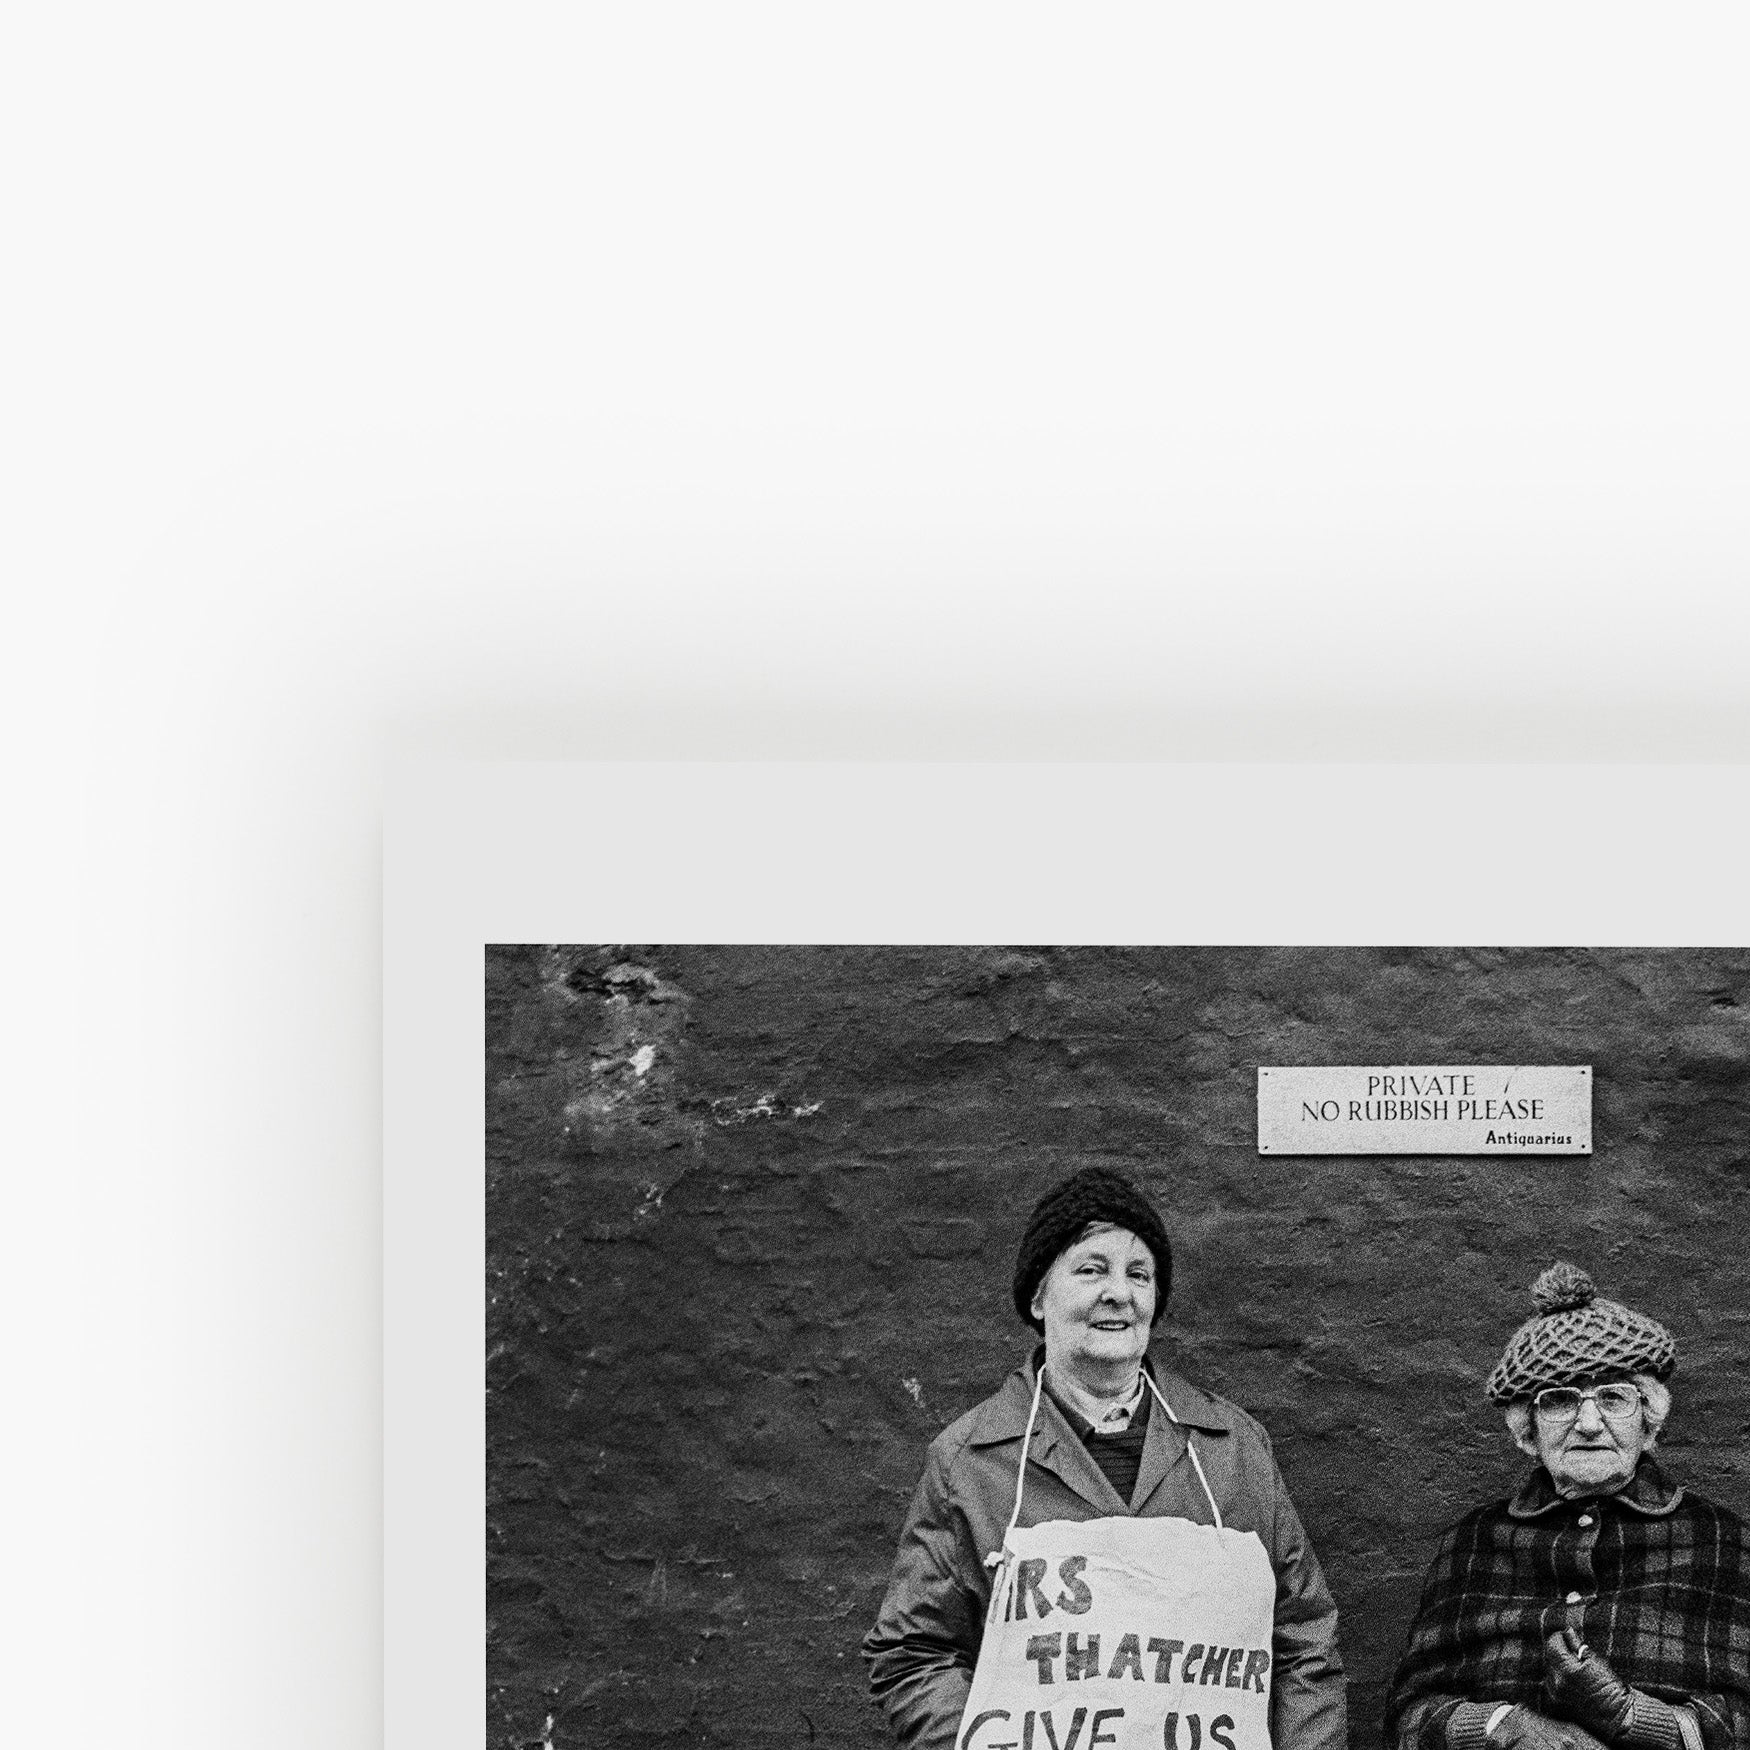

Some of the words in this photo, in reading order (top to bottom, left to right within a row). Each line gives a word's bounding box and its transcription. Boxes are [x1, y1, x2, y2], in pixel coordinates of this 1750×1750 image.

[1367, 1075, 1476, 1096] PRIVATE
[1301, 1101, 1340, 1121] NO
[1348, 1101, 1448, 1121] RUBBISH
[1457, 1099, 1545, 1121] PLEASE
[1485, 1130, 1573, 1147] Antiquarius
[1025, 1632, 1270, 1693] THATCHER
